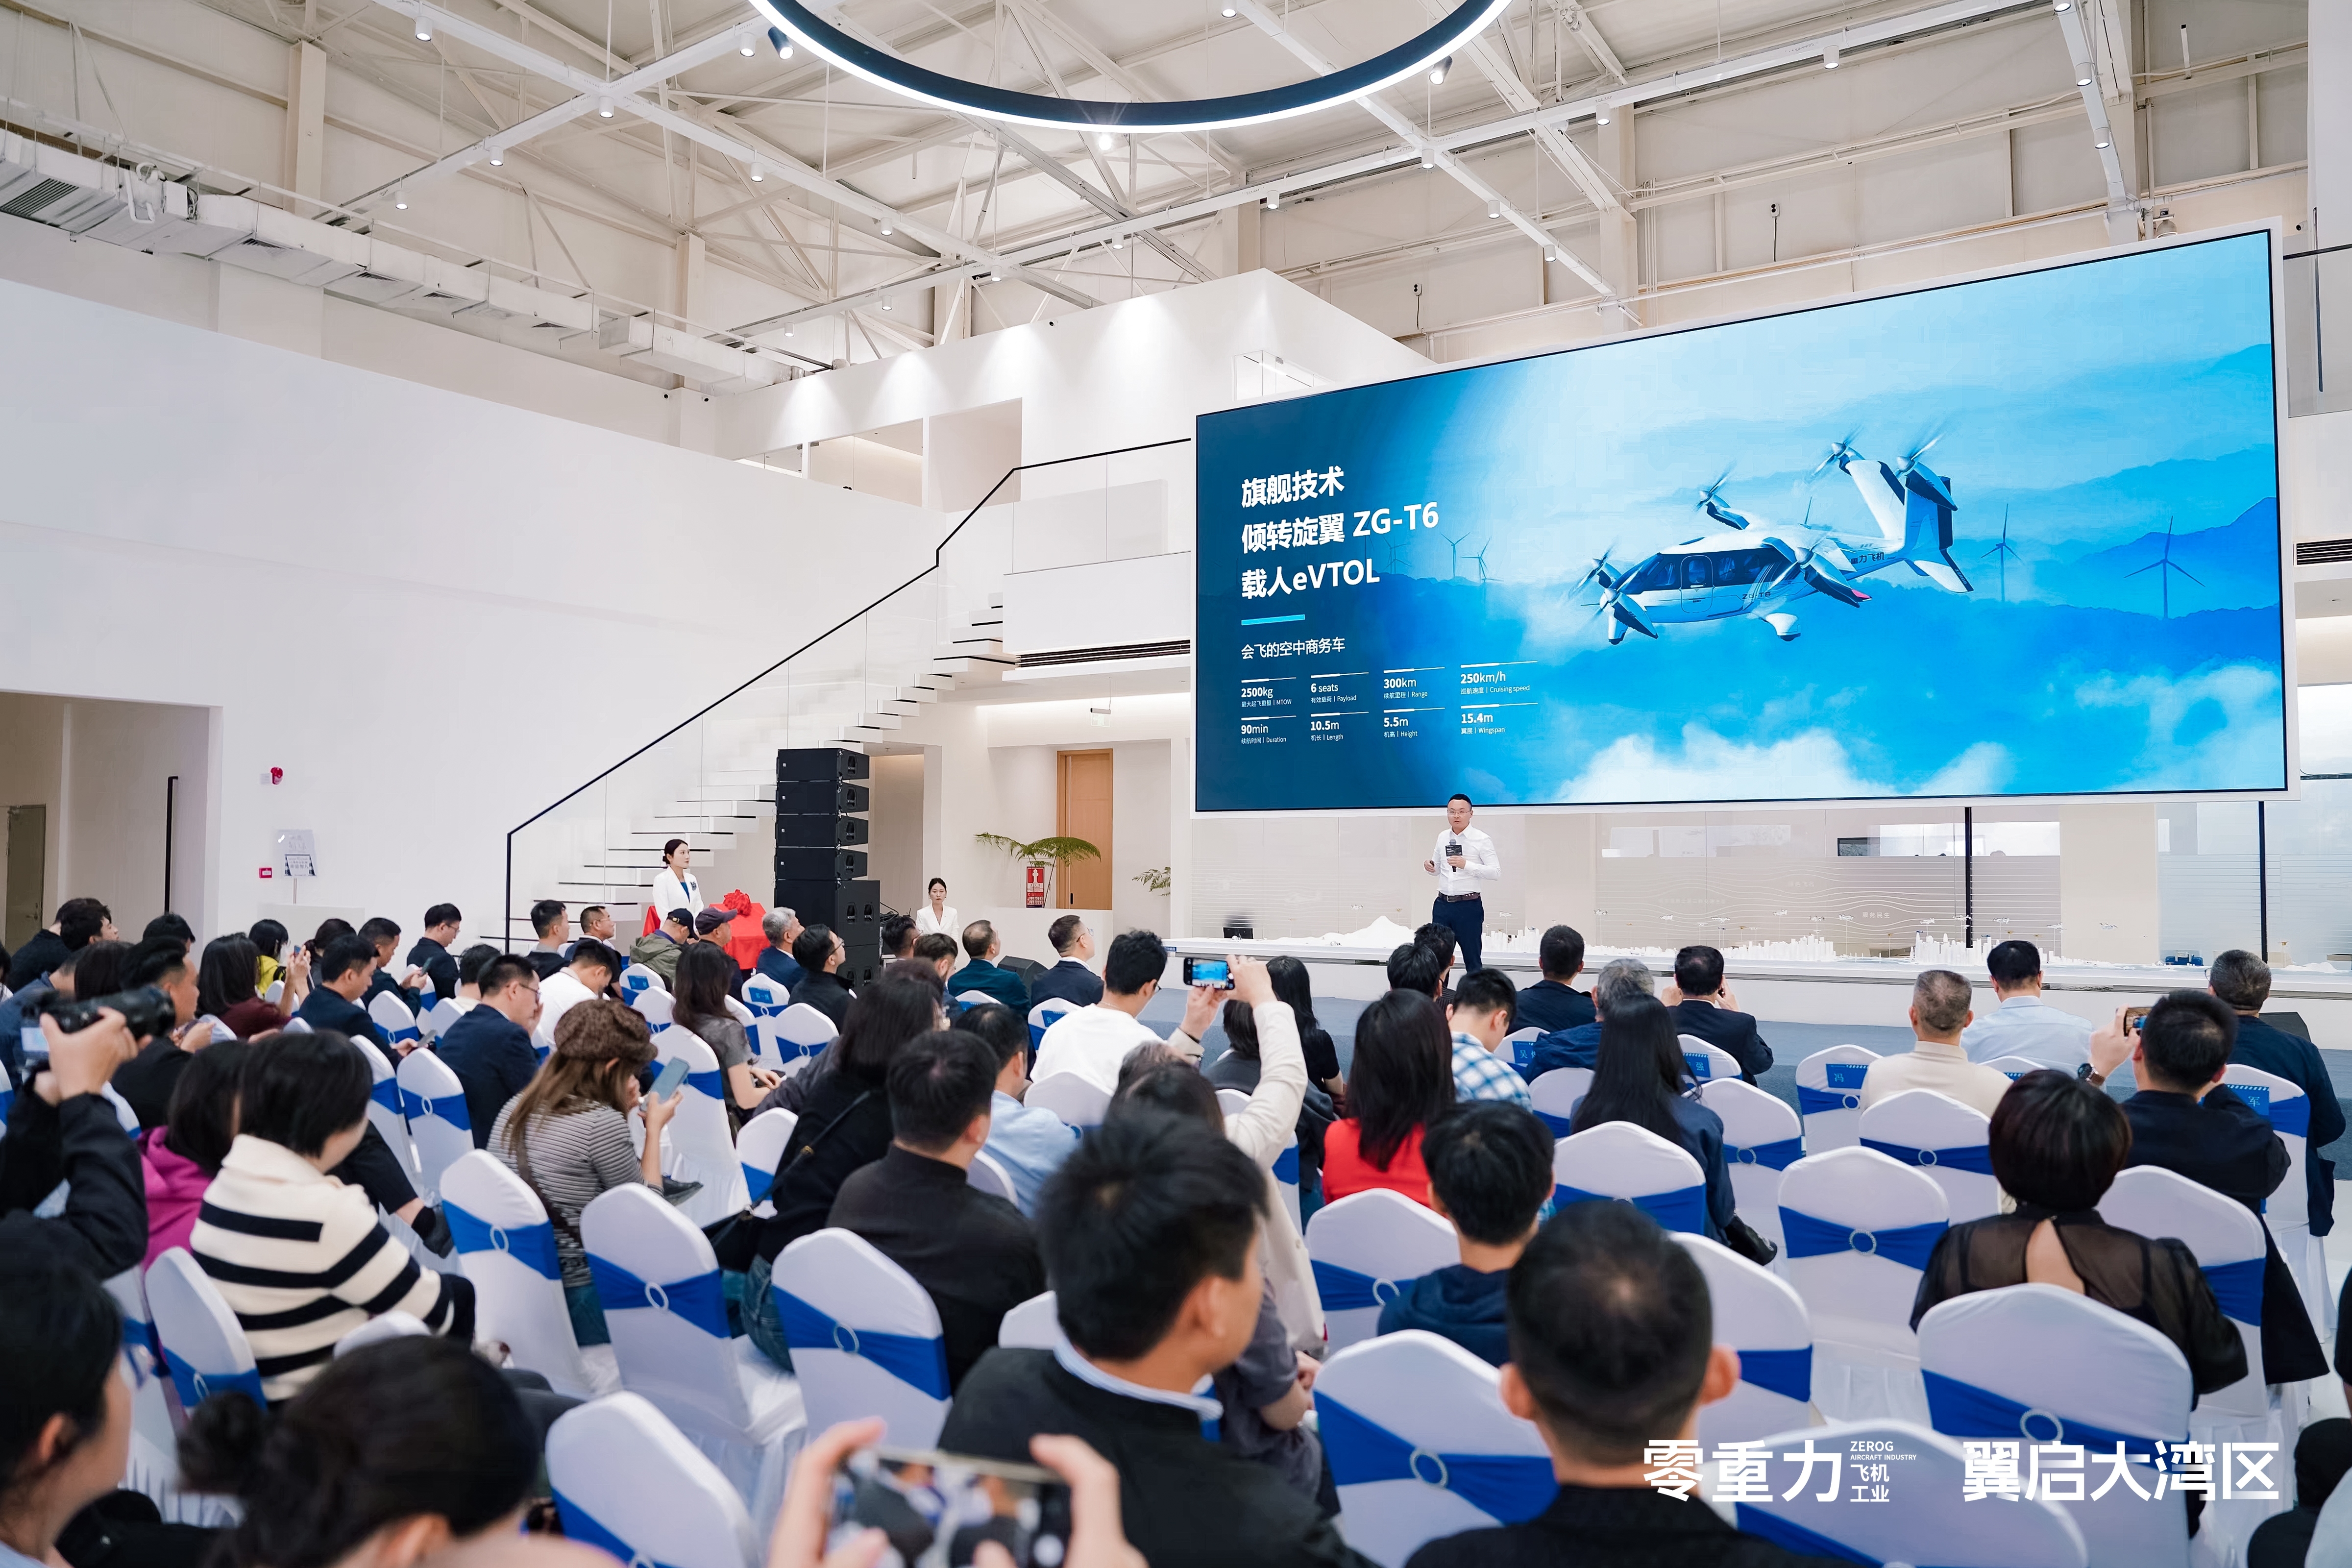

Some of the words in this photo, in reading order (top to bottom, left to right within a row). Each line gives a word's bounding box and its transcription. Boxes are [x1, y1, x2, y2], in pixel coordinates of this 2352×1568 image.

[1241, 466, 1345, 508] 旗舰技术
[1241, 513, 1345, 554] 倾转旋翼
[1353, 502, 1439, 537] ZG-T6
[1241, 558, 1380, 599] 载人eVTOL
[1241, 637, 1346, 660] 会飞的空中商务车
[1383, 677, 1417, 689] 300km
[1460, 671, 1506, 684] 250km/h
[1241, 686, 1273, 699] 2500kg
[1311, 683, 1317, 693] 6
[1318, 684, 1338, 692] seats
[1383, 717, 1409, 727] 5.5m
[1461, 713, 1493, 724] 15.4m
[1241, 724, 1268, 735] 90min
[1310, 720, 1339, 731] 10.5m
[1834, 1073, 1844, 1082] 冯
[2248, 1096, 2260, 1107] 军
